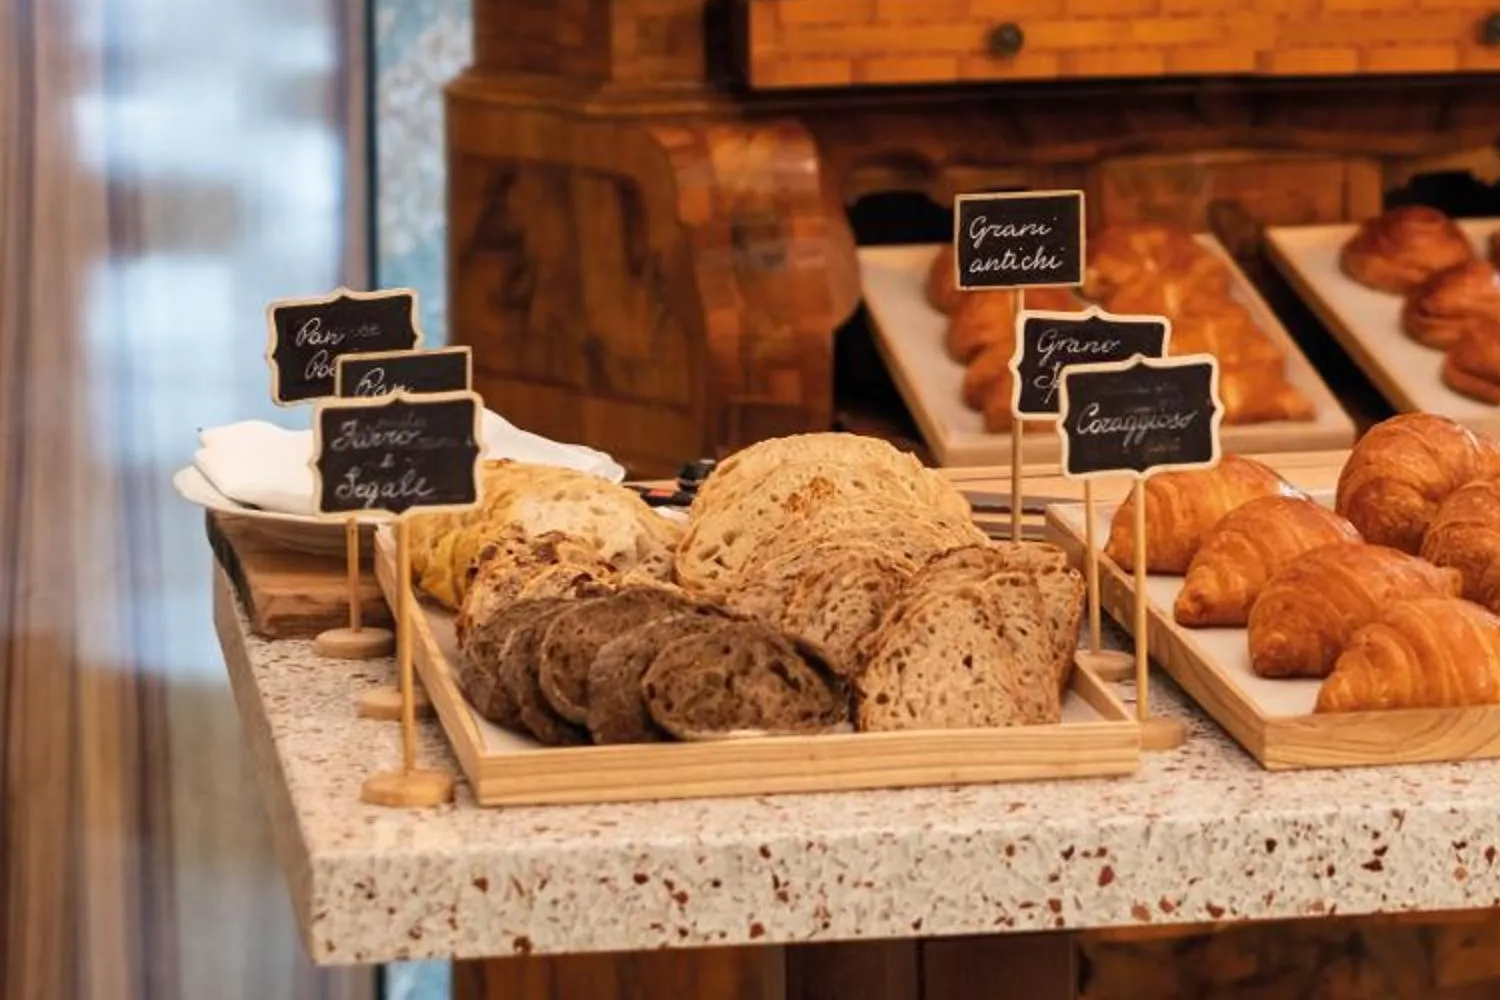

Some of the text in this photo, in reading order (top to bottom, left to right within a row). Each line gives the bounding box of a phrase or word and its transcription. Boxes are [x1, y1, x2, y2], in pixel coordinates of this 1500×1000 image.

[969, 216, 1057, 247] Grani
[969, 246, 1064, 274] antichi
[1036, 328, 1122, 365] Grano
[1076, 402, 1198, 447] Coraggioso
[335, 468, 434, 508] Segale
